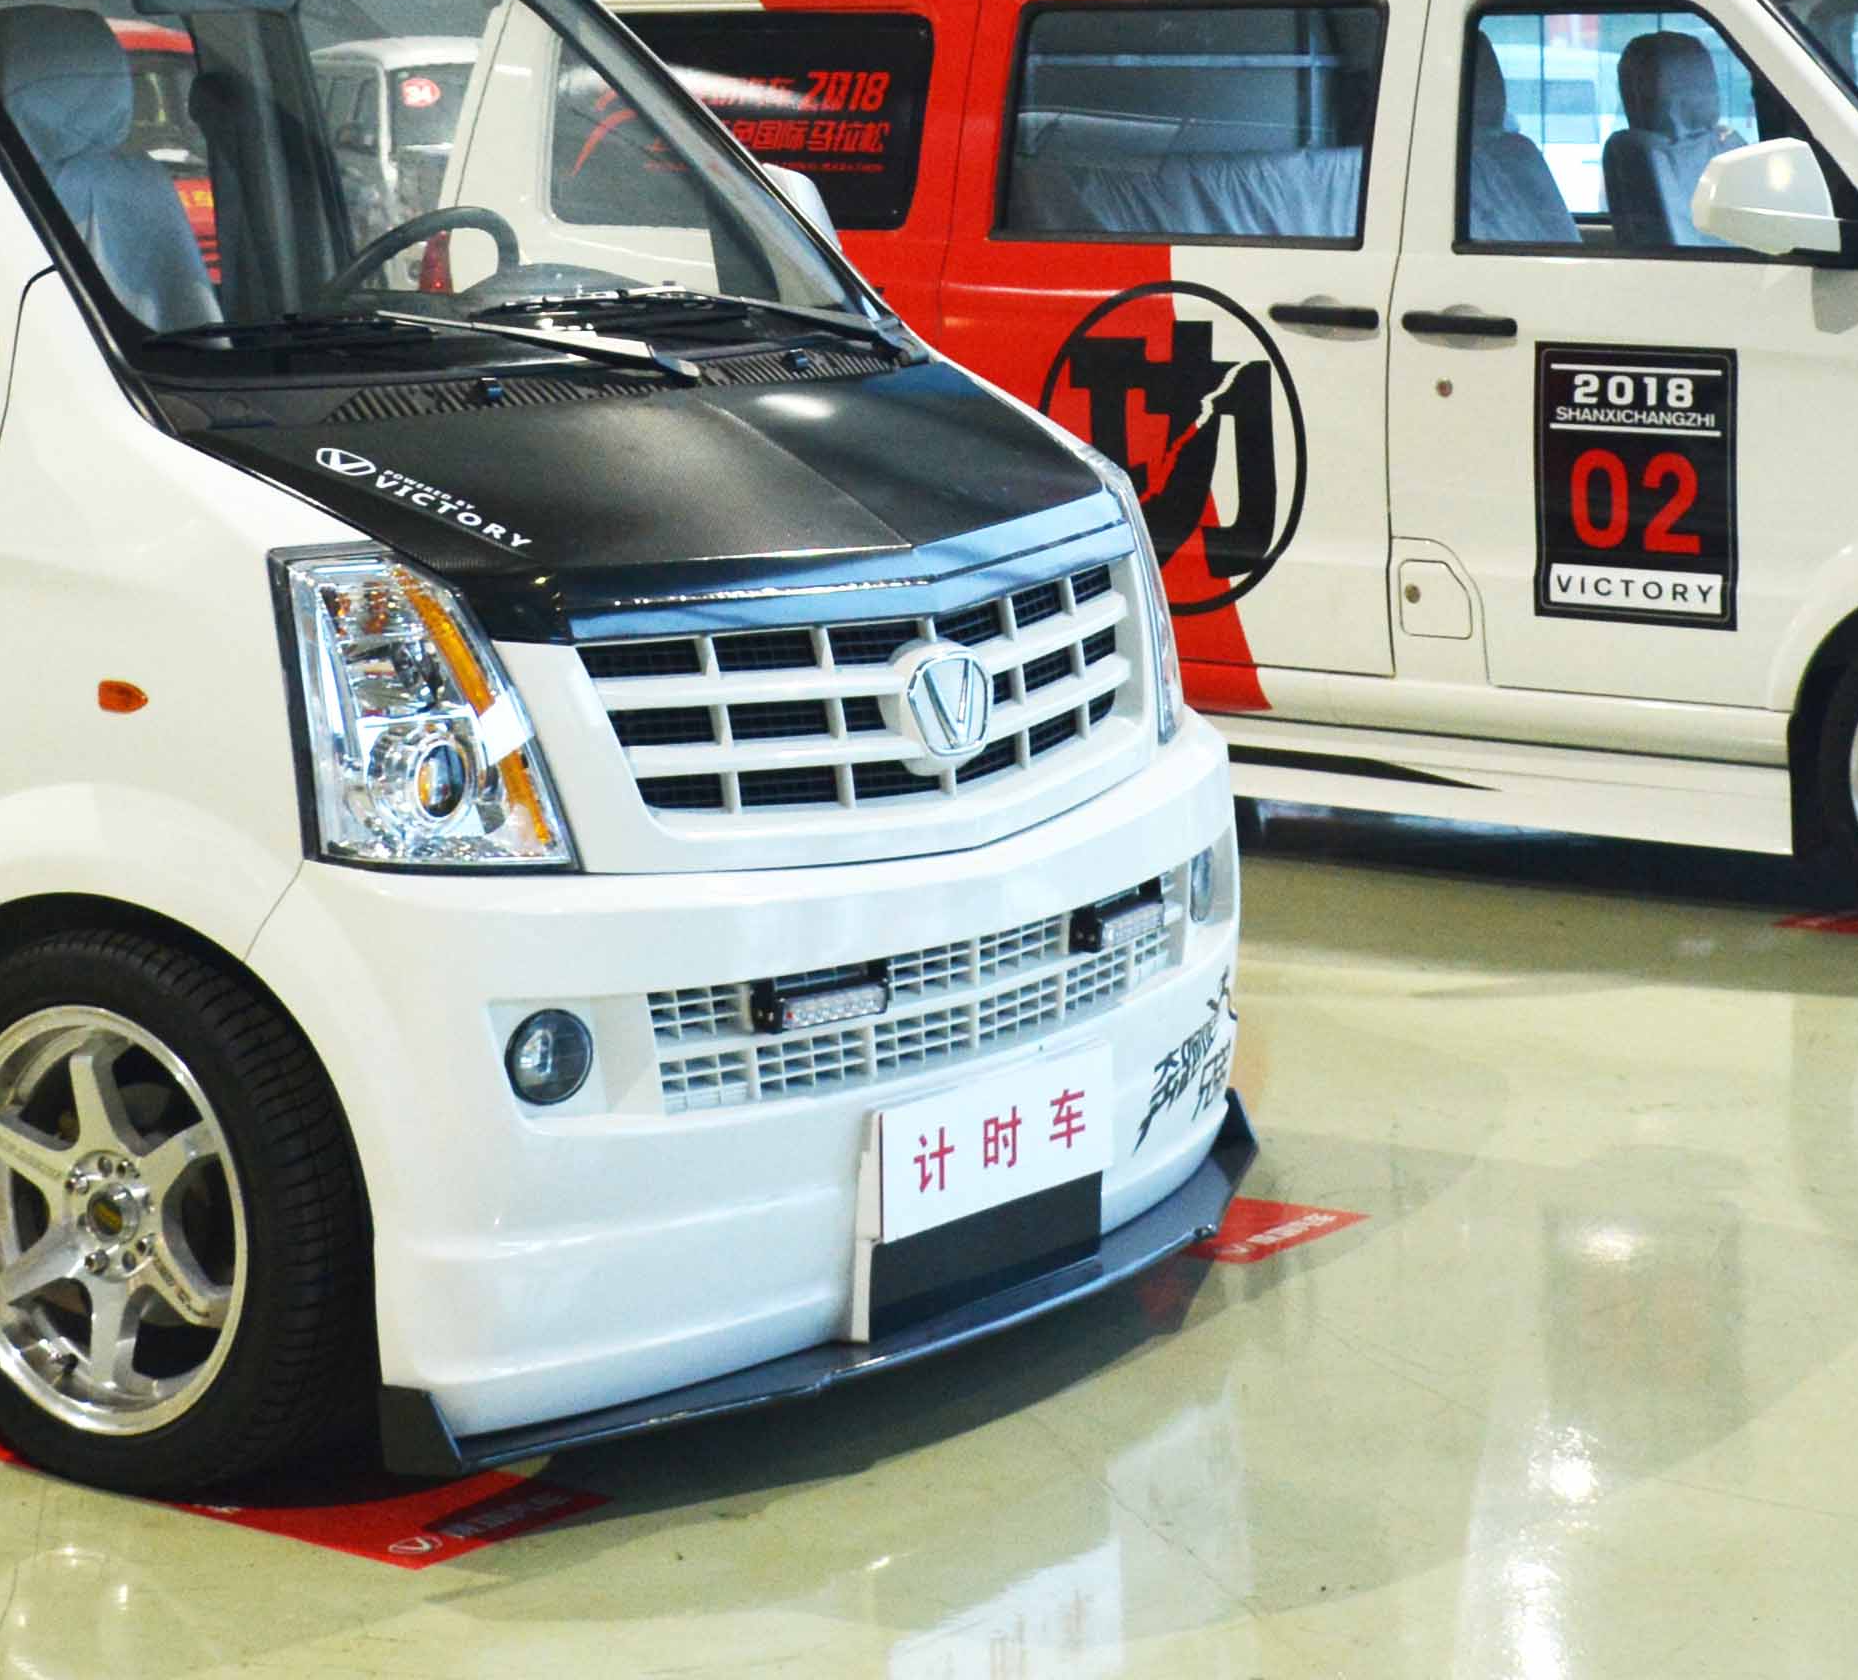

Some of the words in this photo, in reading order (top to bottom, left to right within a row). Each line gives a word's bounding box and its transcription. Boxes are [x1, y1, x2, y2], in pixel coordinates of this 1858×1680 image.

[1556, 406, 1715, 427] SHANXICHANGZHI
[1573, 373, 1693, 408] 2018
[375, 475, 532, 547] VICTORY
[1571, 448, 1701, 555] 02
[1556, 575, 1714, 603] VICTORY
[913, 1088, 1087, 1194] 计时车
